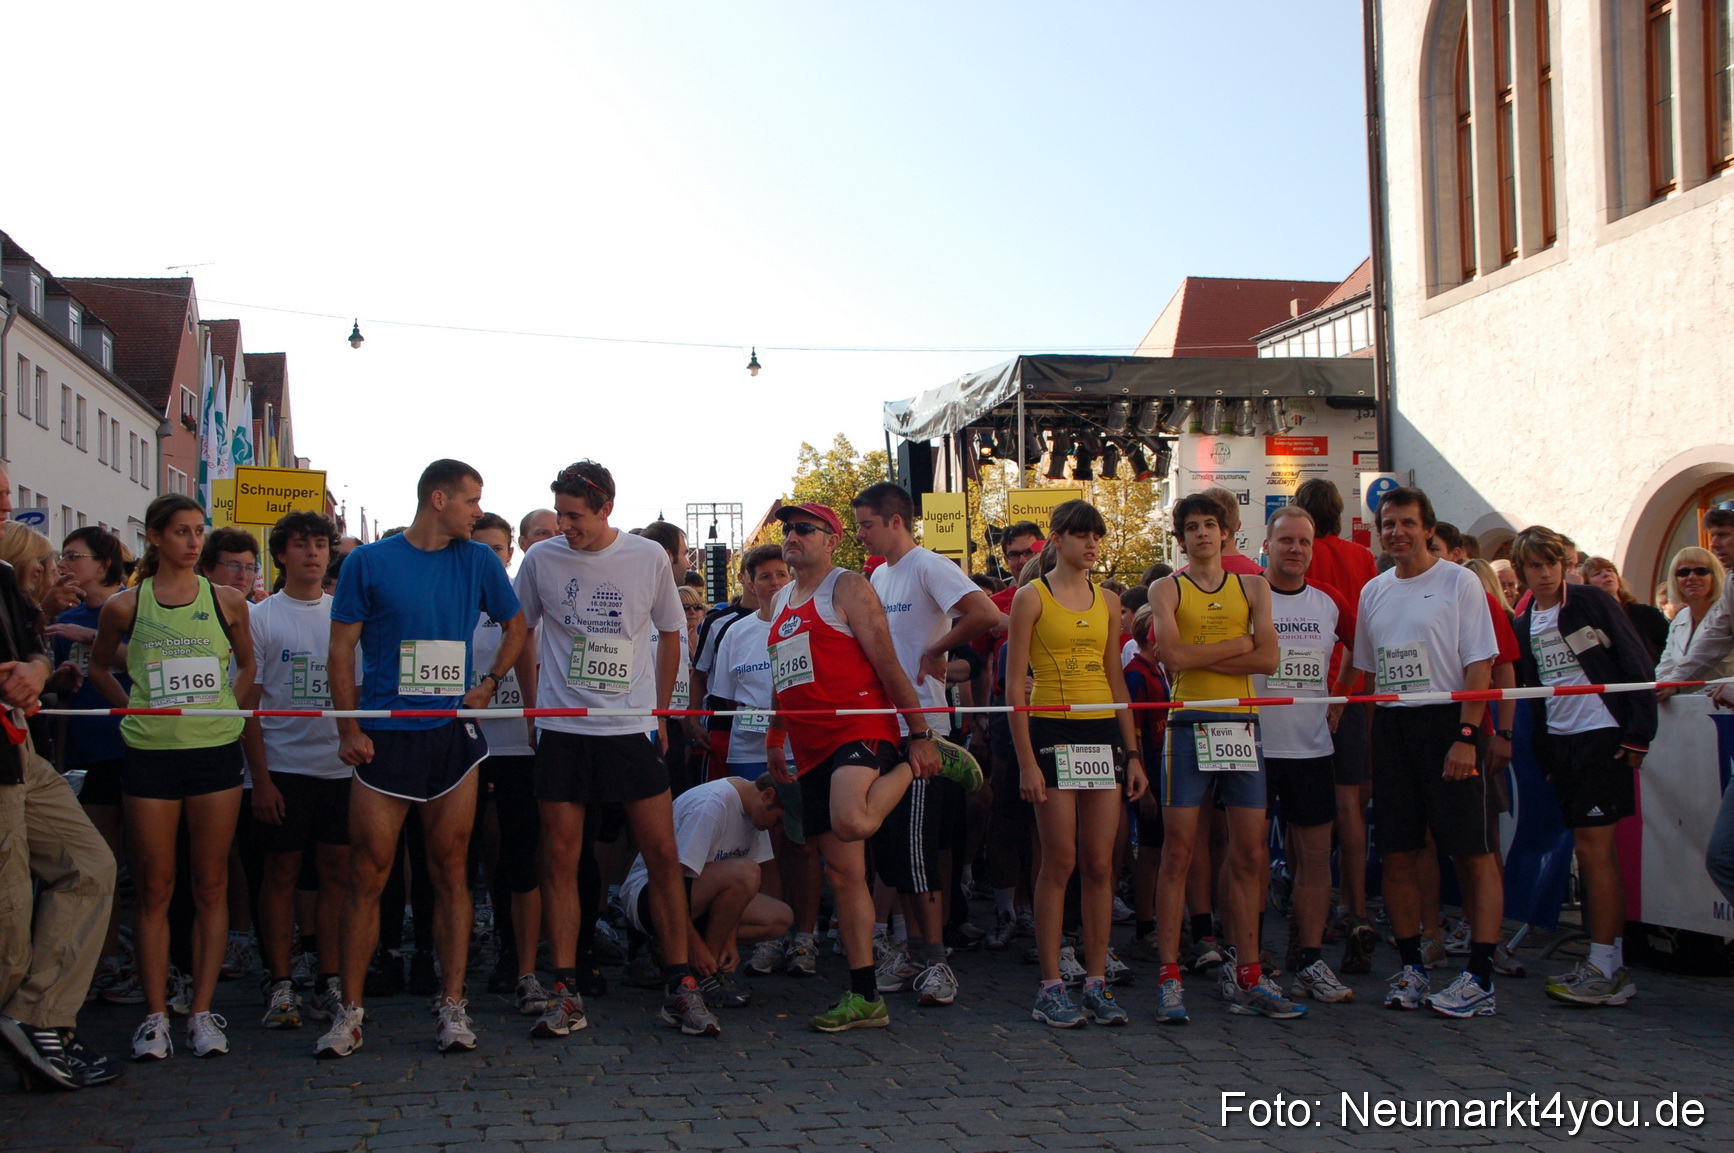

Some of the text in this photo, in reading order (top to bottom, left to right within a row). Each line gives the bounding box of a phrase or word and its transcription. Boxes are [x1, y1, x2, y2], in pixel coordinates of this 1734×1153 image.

[240, 483, 319, 500] Schnupper-
[214, 498, 233, 510] Jug
[266, 501, 292, 513] lauf
[1012, 504, 1055, 516] Schnu
[924, 510, 964, 523] Jugend-
[936, 523, 954, 533] lauf
[1035, 520, 1050, 529] lau
[564, 616, 622, 628] 8. Neumarkter
[1274, 622, 1321, 634] RDINGER
[586, 626, 622, 634] Stadtlauf
[143, 637, 210, 650] new balance
[588, 641, 619, 655] Markus
[1386, 648, 1418, 659] Wolfgang
[1545, 650, 1576, 668] 5128
[420, 665, 460, 680] 5165
[587, 660, 628, 678] 5085
[736, 661, 771, 674] Bilanzb
[780, 655, 808, 677] 5186
[1284, 663, 1320, 677] 5188
[1389, 663, 1423, 680] 5131
[169, 673, 215, 691] 5166
[312, 680, 329, 693] 51
[675, 681, 688, 693] 091
[493, 691, 520, 704] 129
[1211, 728, 1233, 736] Kevin
[1071, 744, 1100, 753] Vanessa
[1215, 744, 1252, 758] 5080
[1074, 761, 1110, 775] 5000
